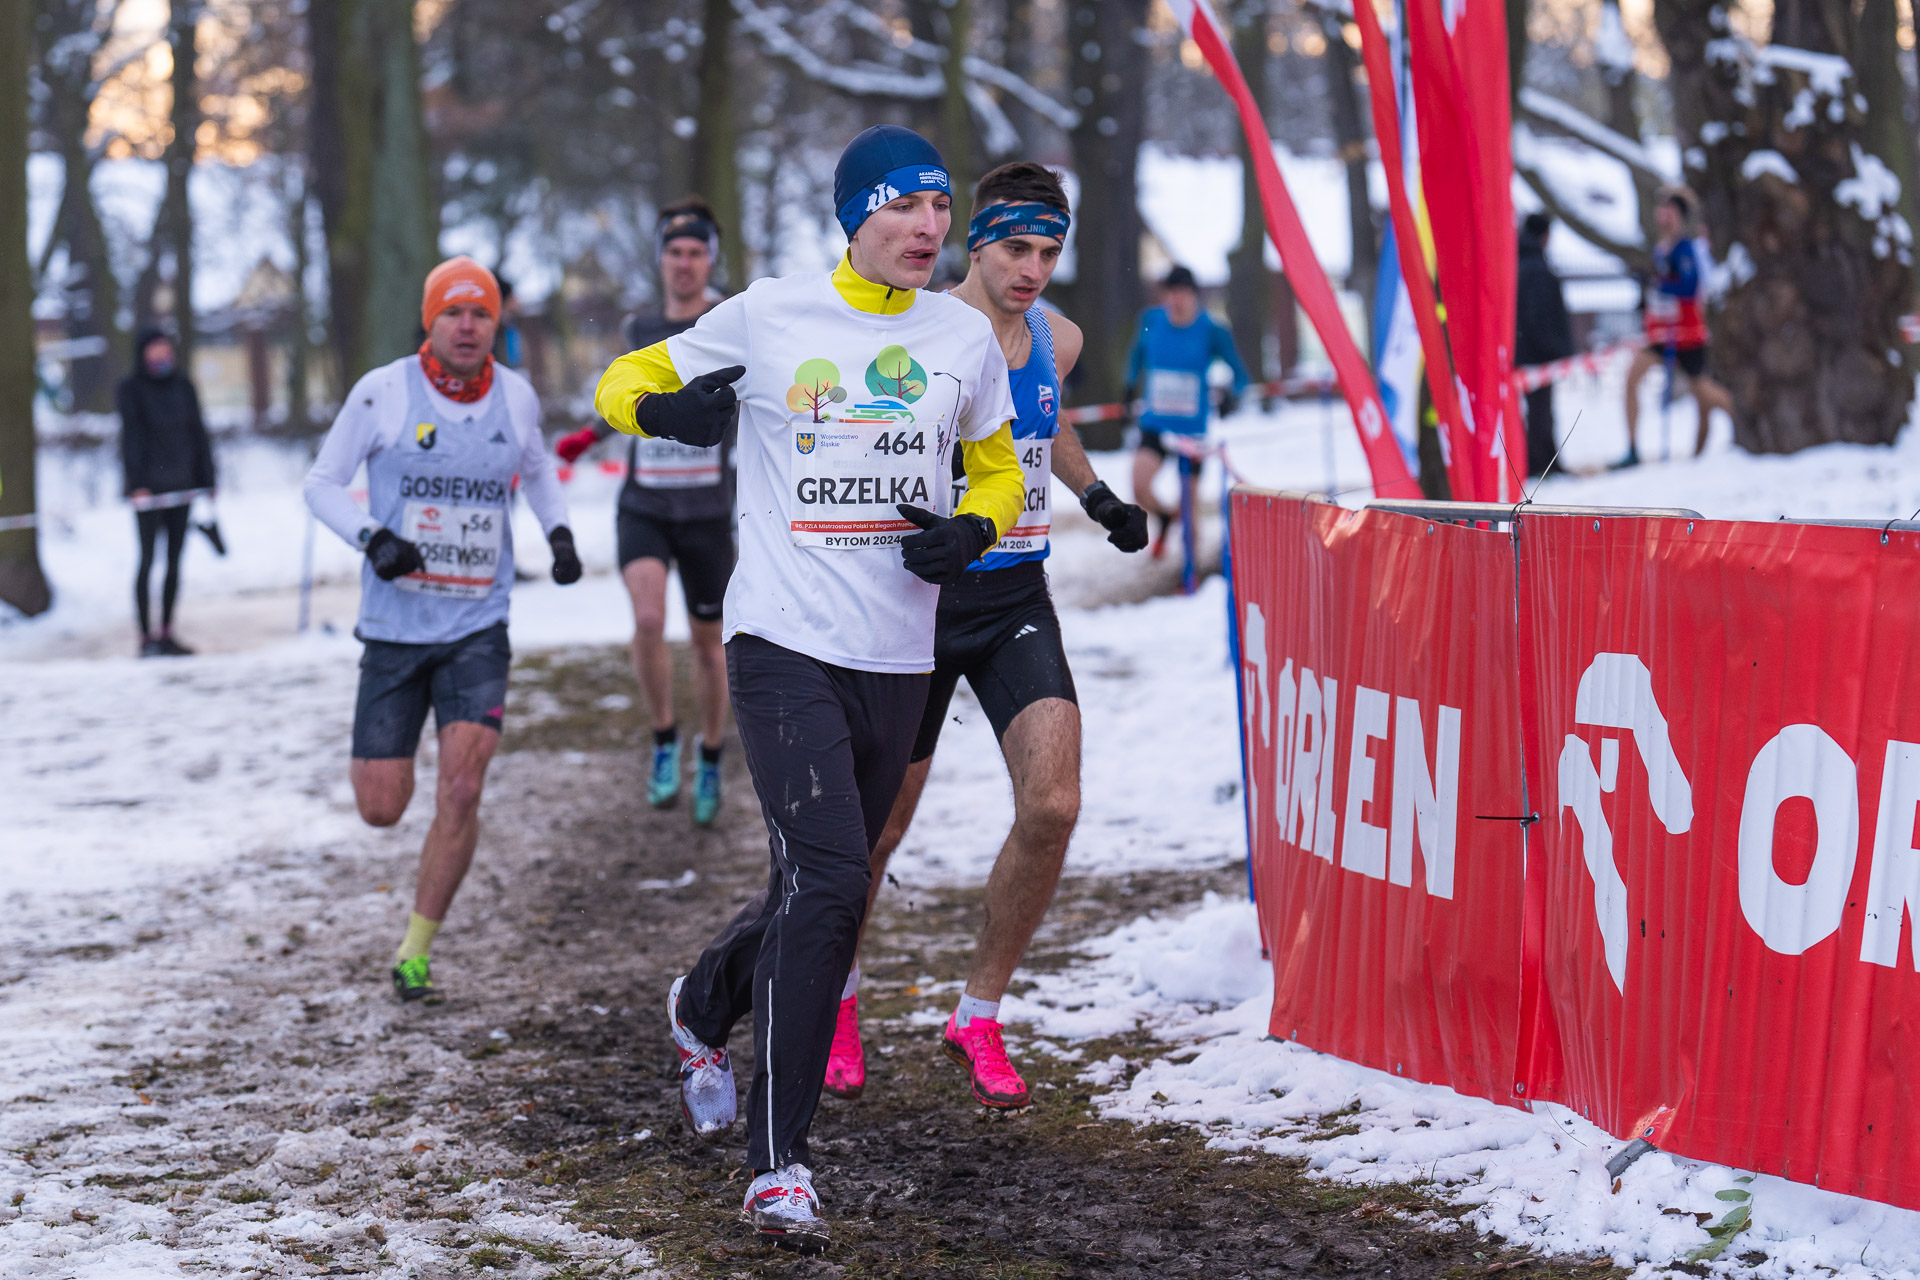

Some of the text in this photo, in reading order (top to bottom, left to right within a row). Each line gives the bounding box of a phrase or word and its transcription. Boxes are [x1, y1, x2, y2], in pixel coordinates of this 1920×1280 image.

[1010, 224, 1047, 234] CHOJNIK
[873, 432, 926, 455] 464
[1022, 447, 1043, 468] 45
[796, 476, 929, 504] GRZELKA
[470, 514, 492, 532] 56
[825, 535, 901, 546] BYTOM 2024
[1010, 540, 1033, 549] 2024
[417, 542, 497, 566] OSIEWSKI
[1275, 657, 1462, 901] ORLEN
